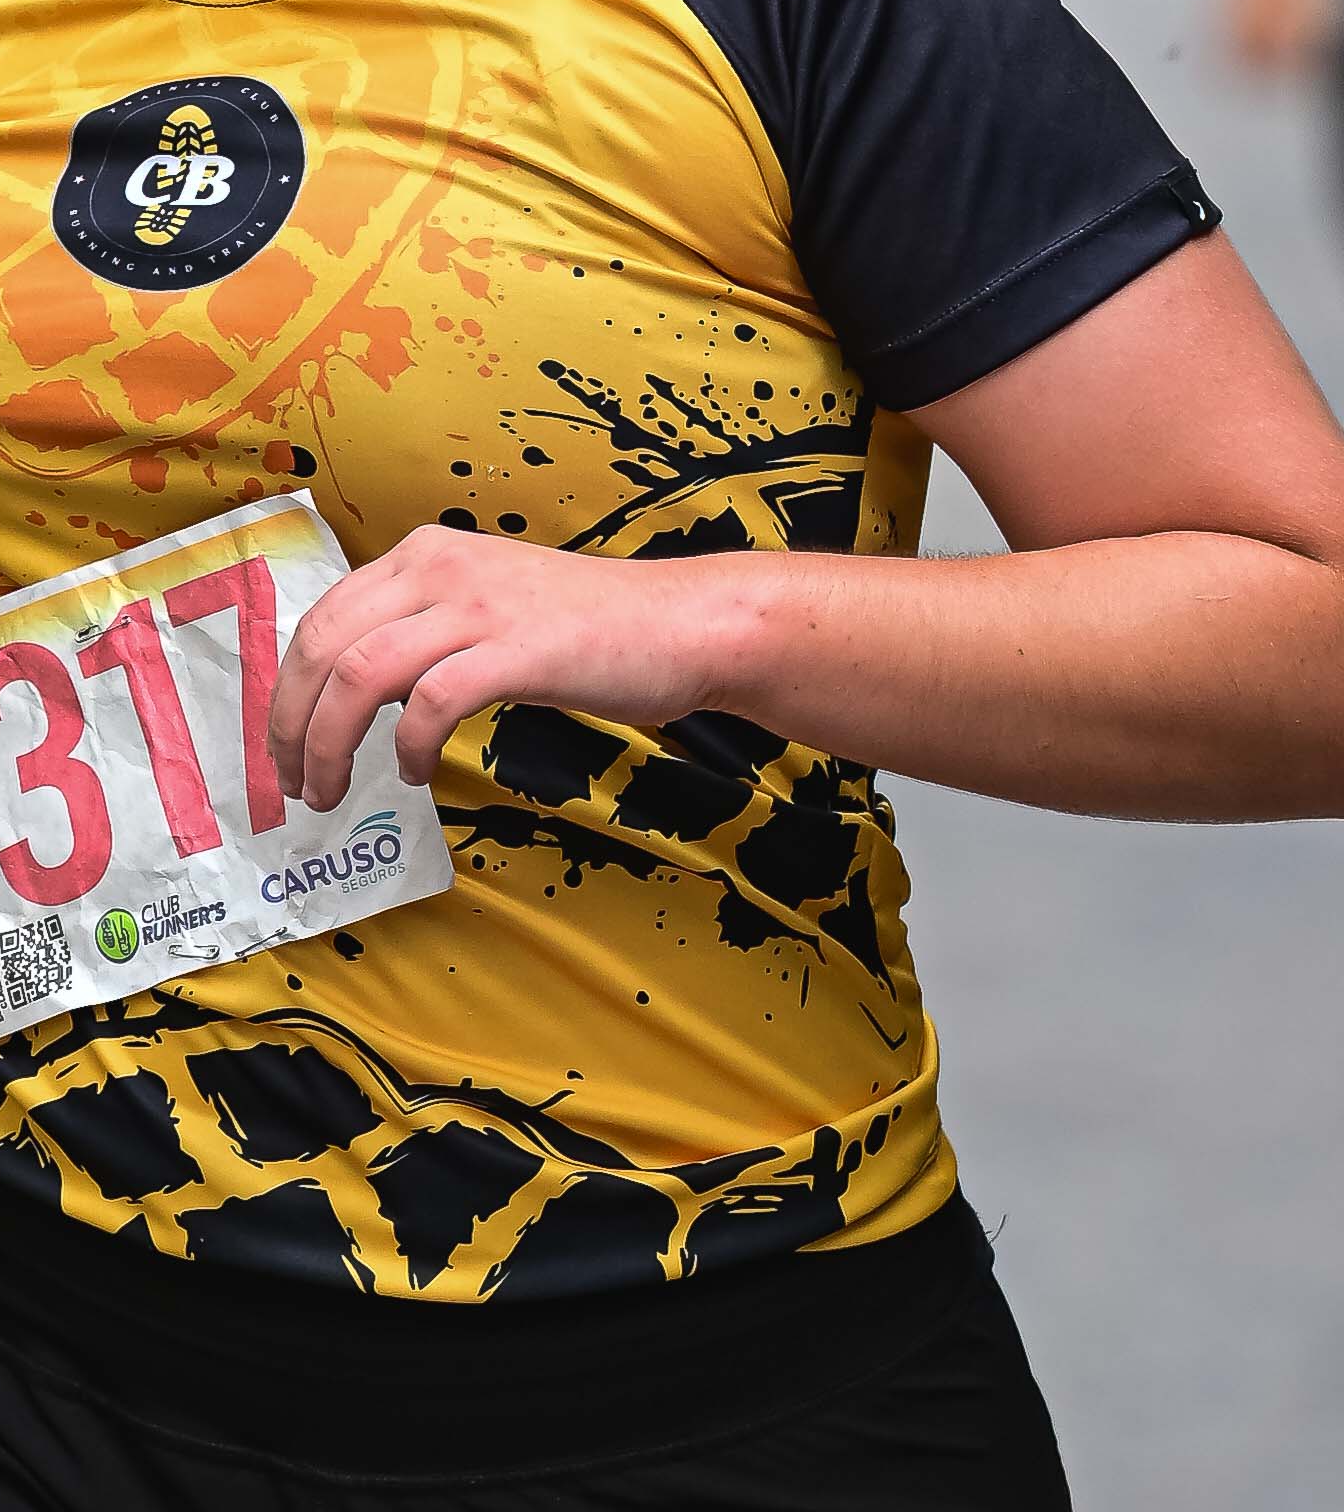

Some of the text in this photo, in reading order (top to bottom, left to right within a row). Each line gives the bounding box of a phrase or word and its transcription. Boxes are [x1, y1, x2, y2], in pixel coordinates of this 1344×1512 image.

[240, 87, 279, 123] CLUB
[124, 154, 236, 207] CB
[69, 208, 267, 276] RUNNING AND TRAIL
[261, 833, 402, 904] CARUSO
[341, 863, 406, 894] SEGUROS
[141, 894, 181, 924] CLUB
[141, 901, 227, 946] RUNNER'S
